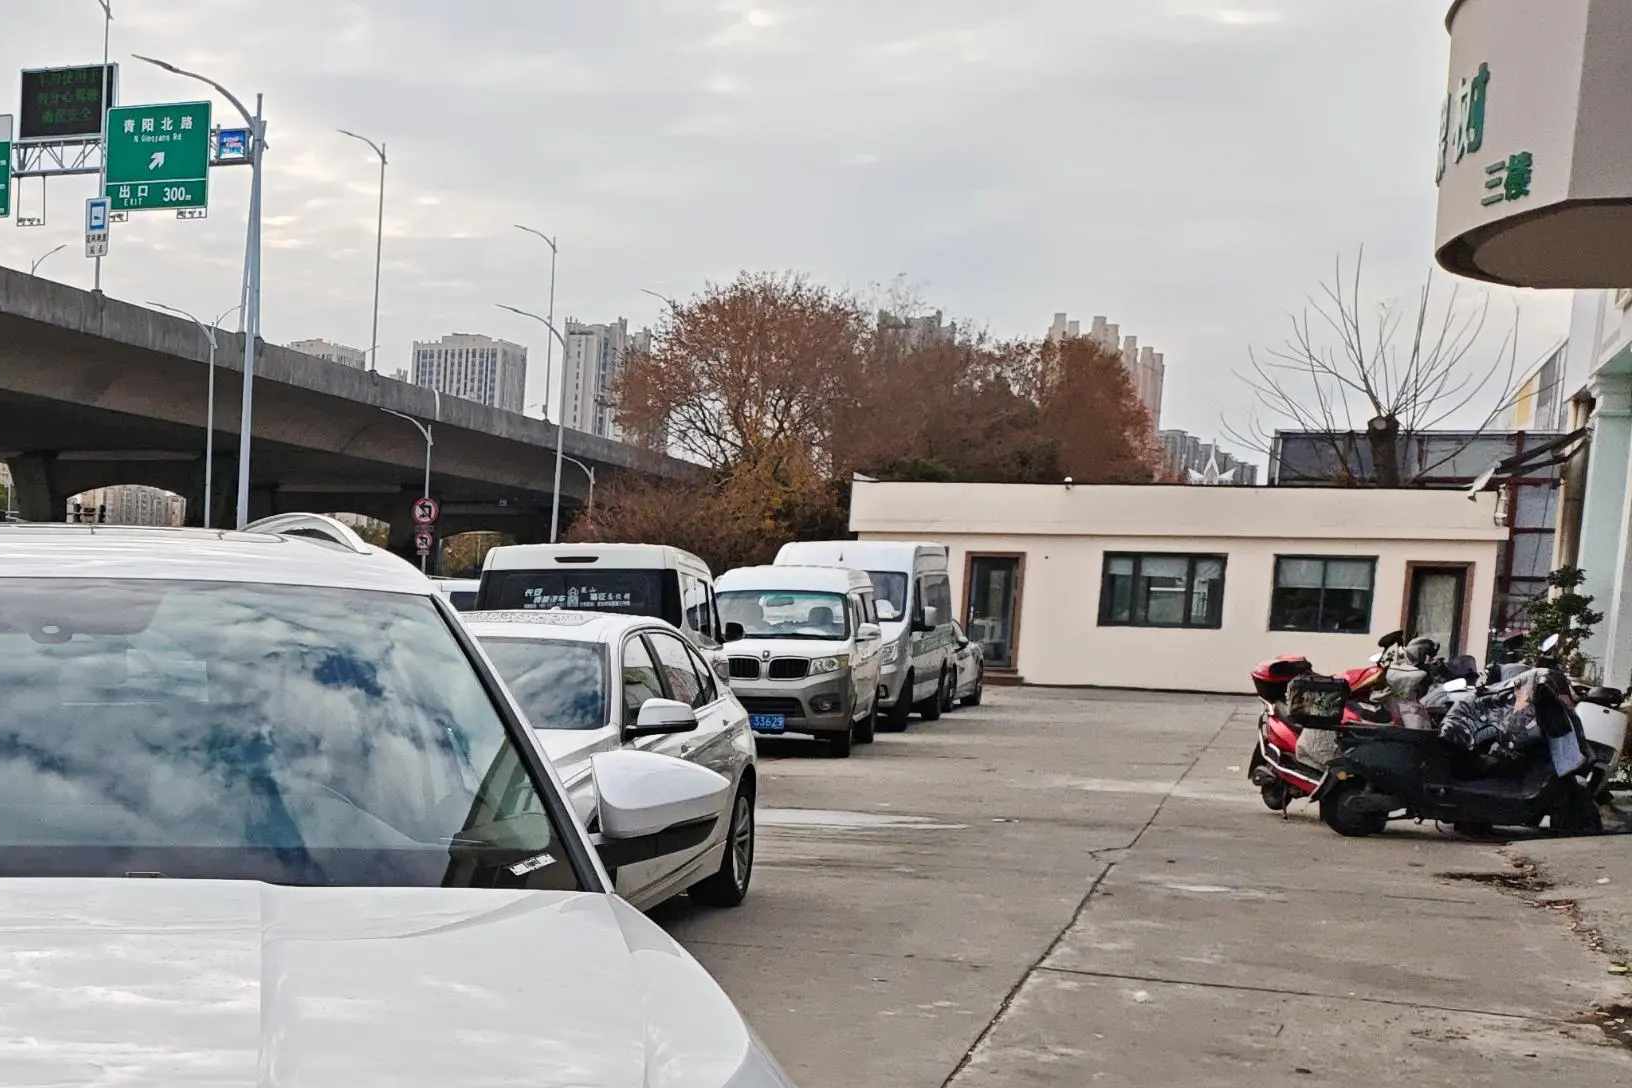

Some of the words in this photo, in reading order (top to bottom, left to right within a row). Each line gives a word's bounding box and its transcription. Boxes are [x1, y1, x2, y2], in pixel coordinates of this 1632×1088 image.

[124, 116, 193, 133] 青阳北路
[172, 133, 182, 141] Rd
[119, 185, 148, 198] 出口
[124, 198, 143, 206] EXIT
